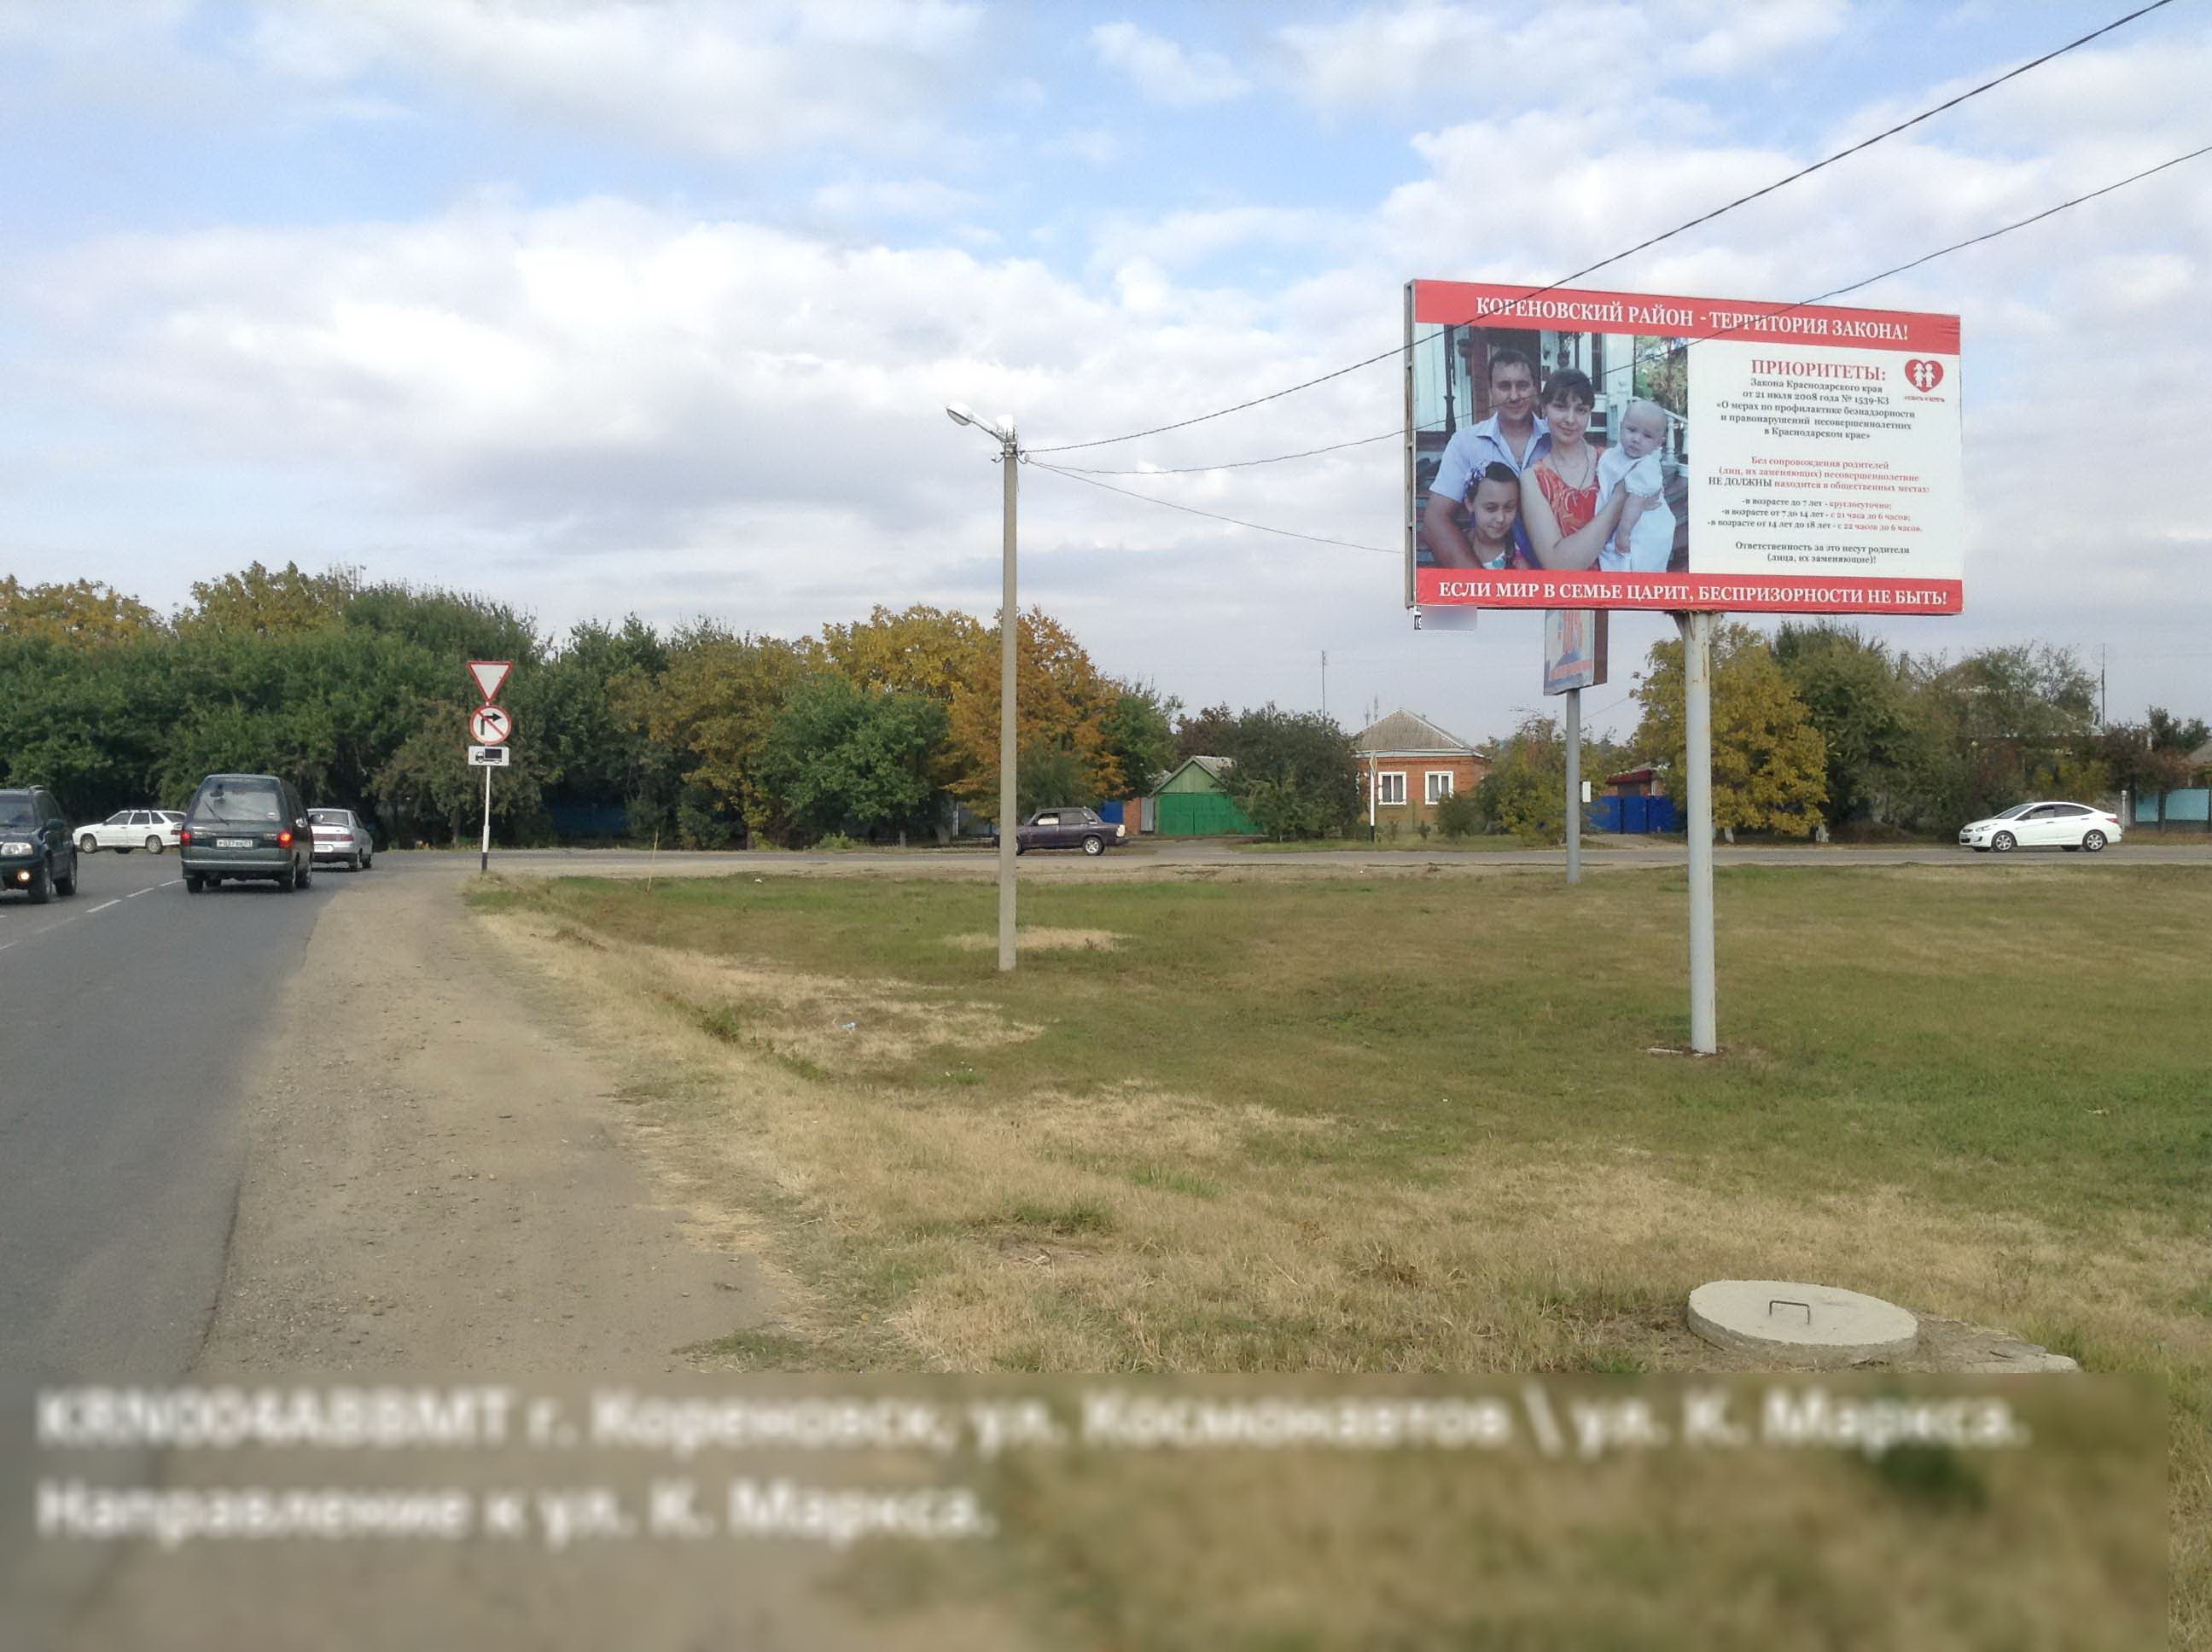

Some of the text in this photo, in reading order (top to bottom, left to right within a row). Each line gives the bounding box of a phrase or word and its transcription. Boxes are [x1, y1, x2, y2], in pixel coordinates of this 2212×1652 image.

[1476, 297, 1623, 323] КОРЕНОВСКИЙ
[1628, 305, 1694, 327] РАЙОН
[1831, 319, 1909, 340] ЗАКОНА!
[1751, 359, 1886, 381] ПРИОРИТЕТЫ:
[1750, 377, 1883, 394] Закона Краснодарского края
[1755, 391, 1765, 399] 21
[1795, 393, 1818, 402] 2008
[1819, 395, 1839, 404] года
[1854, 396, 1889, 405] 1539-КЗ
[1731, 403, 1759, 411] мерах
[1774, 404, 1842, 416] профилактике
[1843, 406, 1915, 420] безнадзорности
[1729, 415, 1810, 426] правонарушений
[1814, 418, 1912, 430] несовершеннолетних
[1772, 427, 1842, 439] Краснодарском
[1751, 456, 1889, 470] Без сопровождения родителей
[1708, 476, 1723, 486] НЕ
[1724, 477, 1773, 487] ДОЛЖНЫ
[1830, 481, 1896, 492] общественных
[1752, 498, 1790, 508] возрасте
[1732, 509, 1769, 518] возрасте
[1718, 520, 1755, 529] возрасте
[1807, 521, 1816, 529] 18
[1736, 541, 1813, 551] Ответственность
[1842, 545, 1866, 555] несут
[1868, 547, 1910, 556] родители
[1439, 582, 1947, 605] ЕСЛИ МИР В СЕМЬЕ ЦАРИТ, БЕСПРИЗОРНОСТИ НЕ БЫТЬ!
